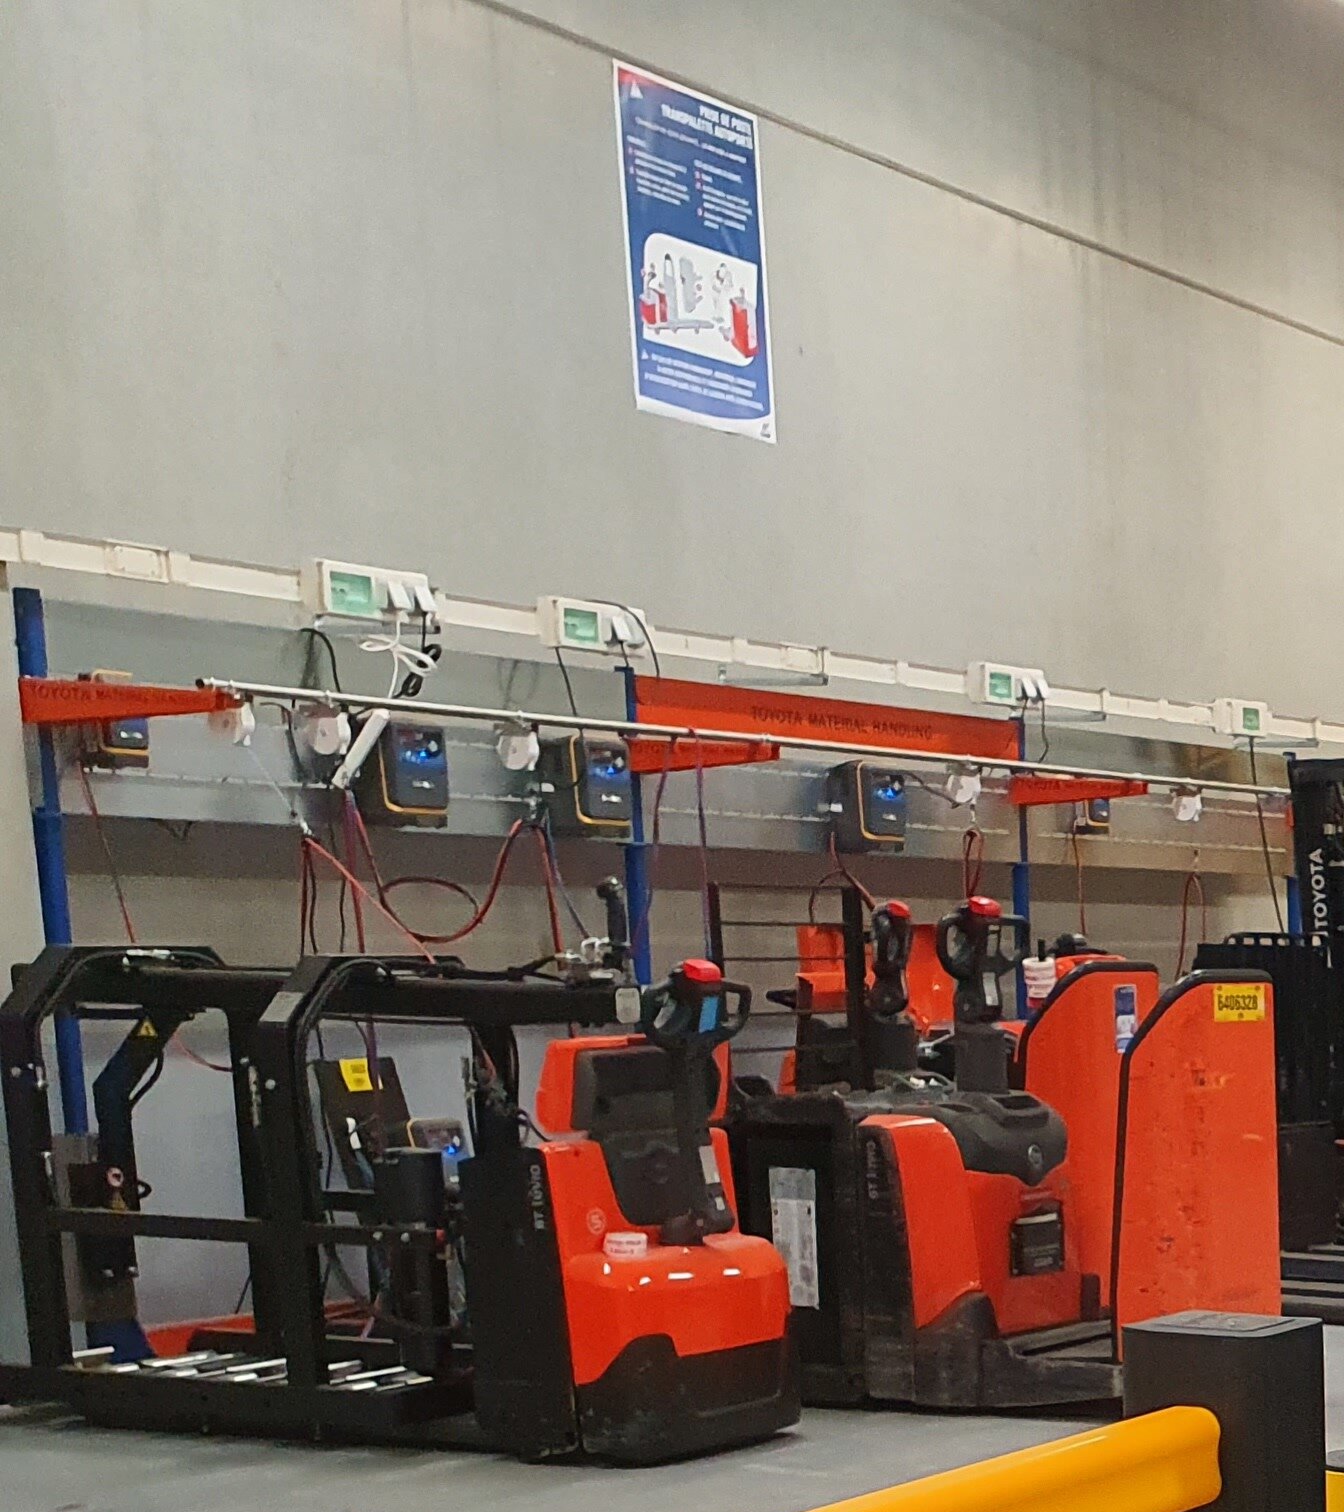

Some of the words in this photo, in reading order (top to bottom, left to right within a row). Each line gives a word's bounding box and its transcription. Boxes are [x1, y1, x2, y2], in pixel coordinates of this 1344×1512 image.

[752, 706, 803, 725] TOYOTA
[871, 717, 933, 740] HANDLING
[1308, 848, 1329, 930] TOYOTA
